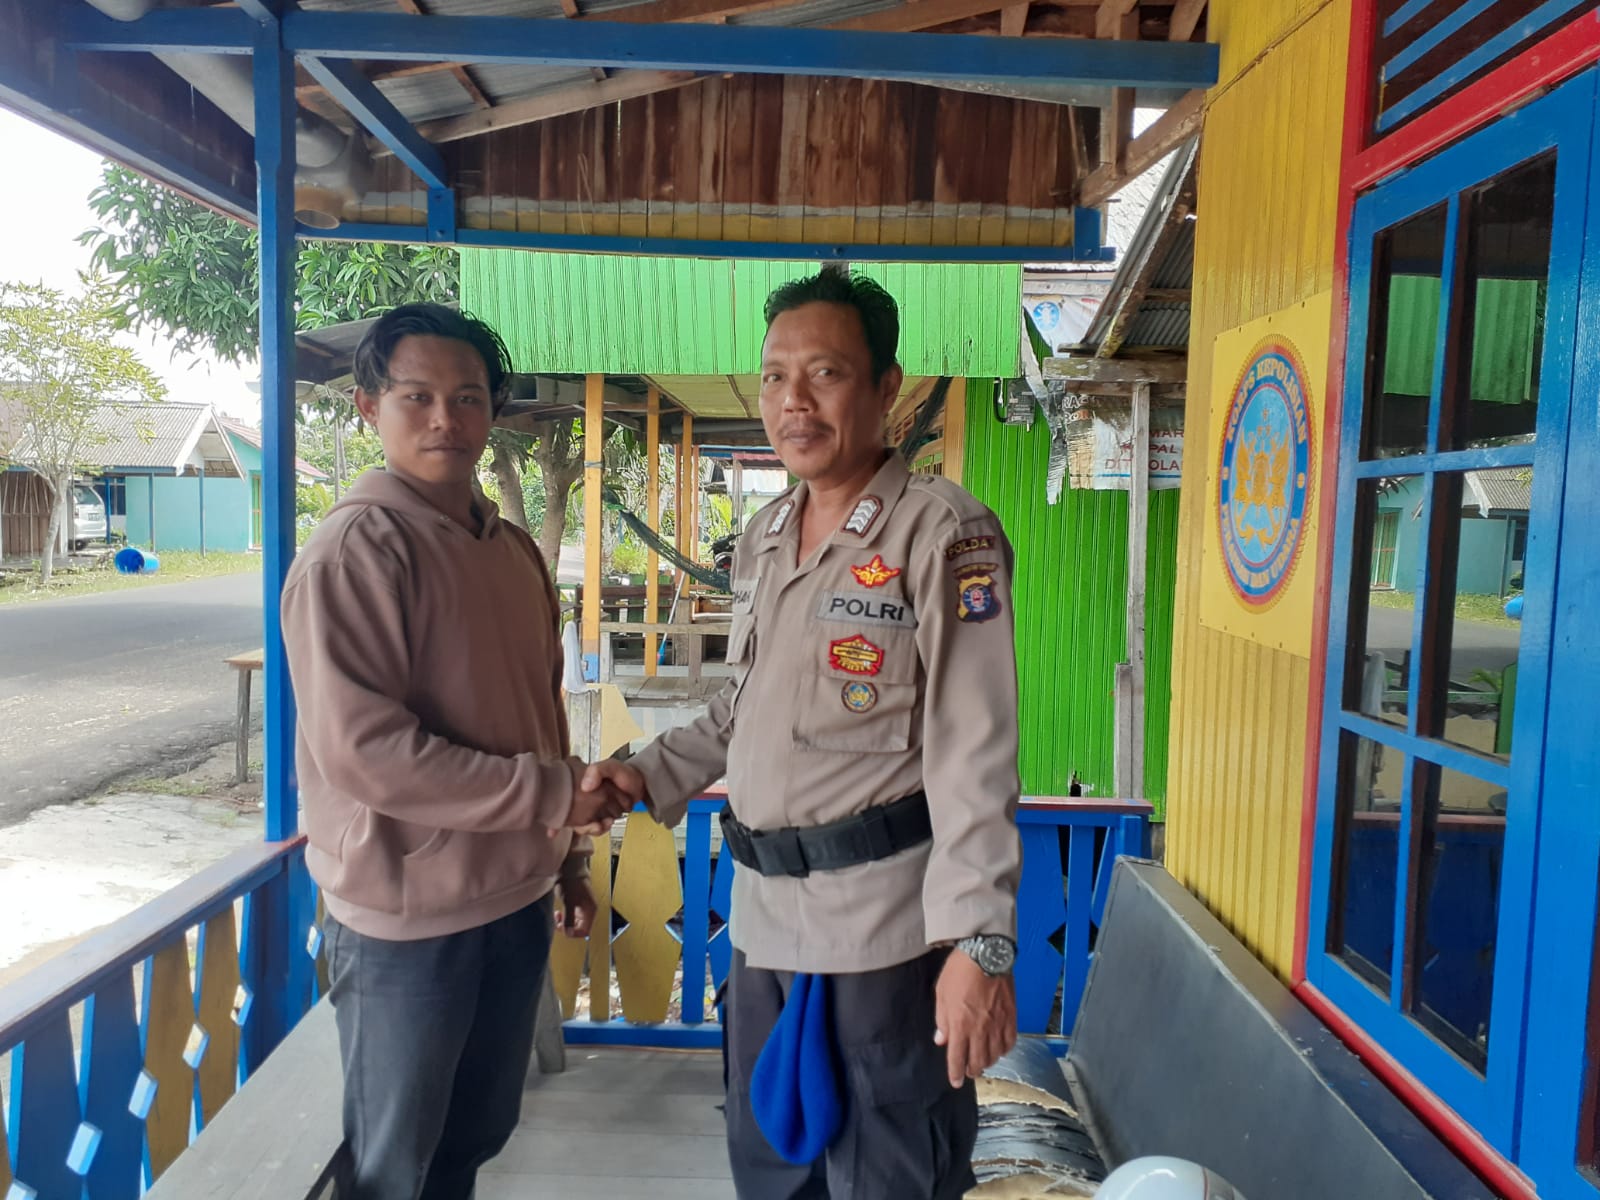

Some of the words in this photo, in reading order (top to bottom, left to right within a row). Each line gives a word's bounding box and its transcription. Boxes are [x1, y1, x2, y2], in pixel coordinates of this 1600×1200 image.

[1226, 370, 1255, 442] KORPS
[1256, 357, 1306, 443] KEPOLISIAN
[1148, 459, 1181, 470] OLA
[947, 538, 990, 554] POLDA
[829, 597, 905, 622] POLRI
